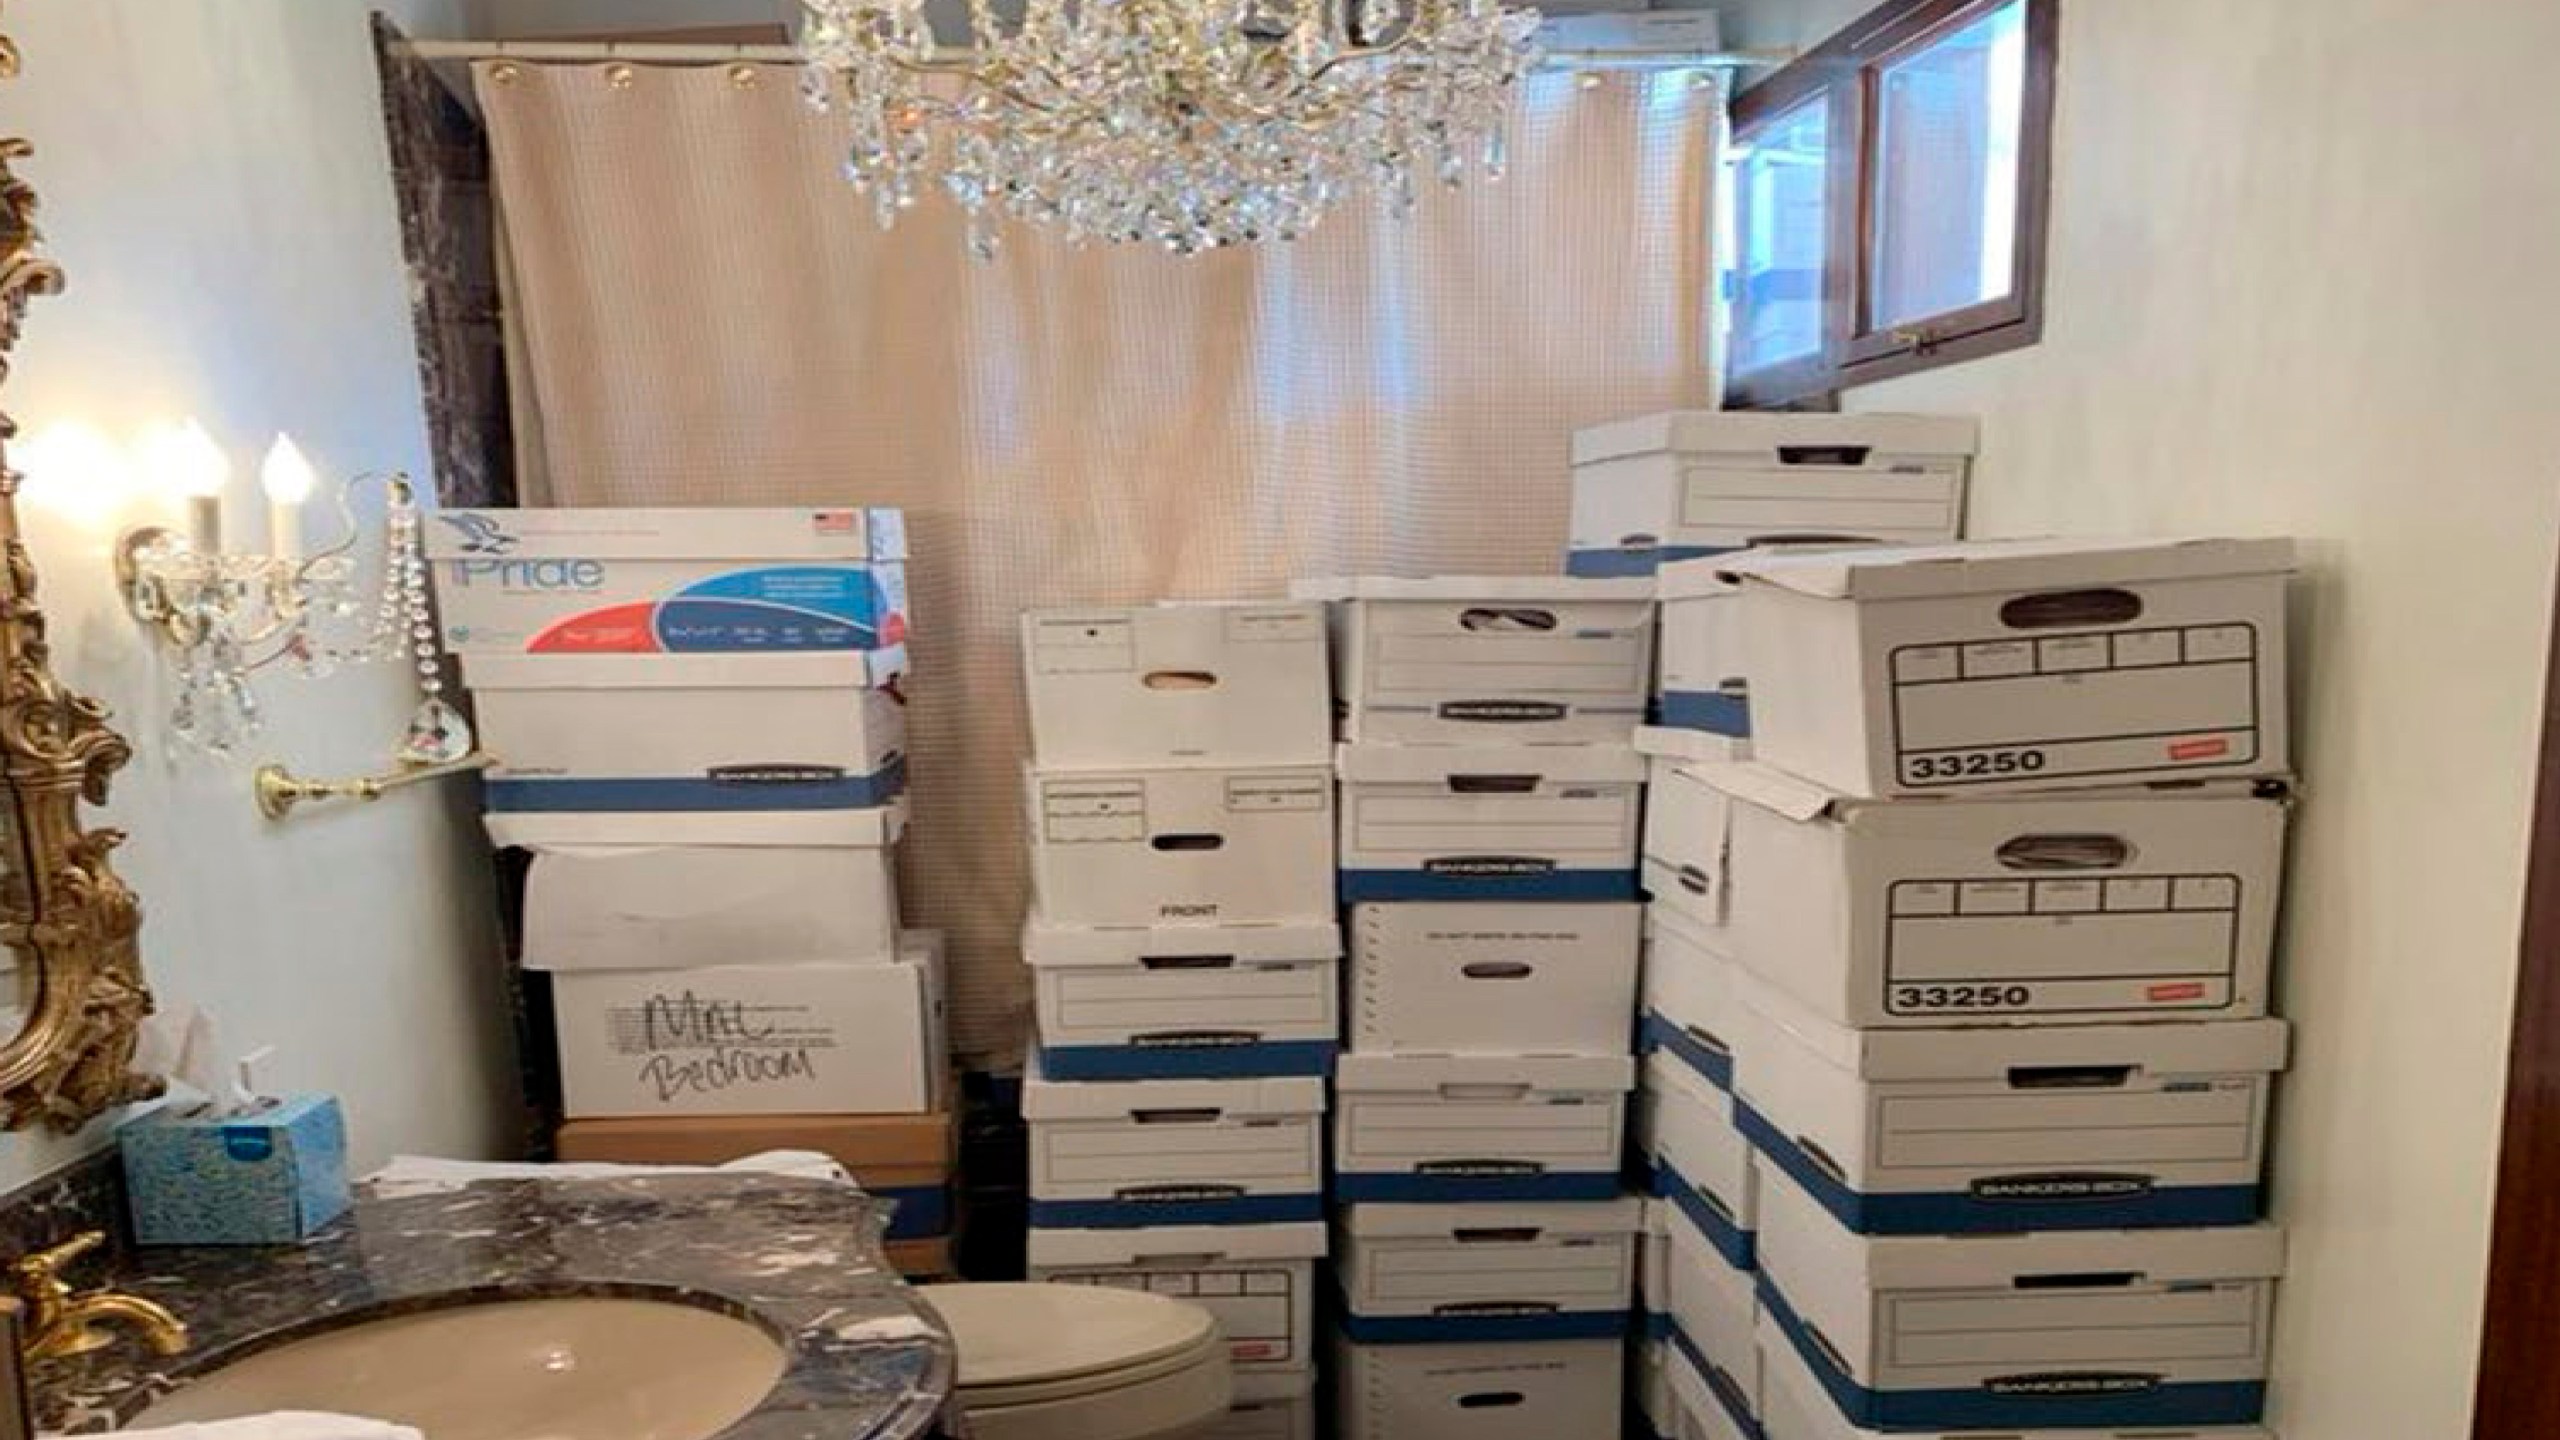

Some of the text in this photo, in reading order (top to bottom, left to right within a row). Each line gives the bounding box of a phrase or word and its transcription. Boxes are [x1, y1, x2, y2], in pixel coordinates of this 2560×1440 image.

[1911, 750, 2045, 779] 33250
[1160, 903, 1218, 918] FRONT
[1897, 984, 2031, 1008] 33250
